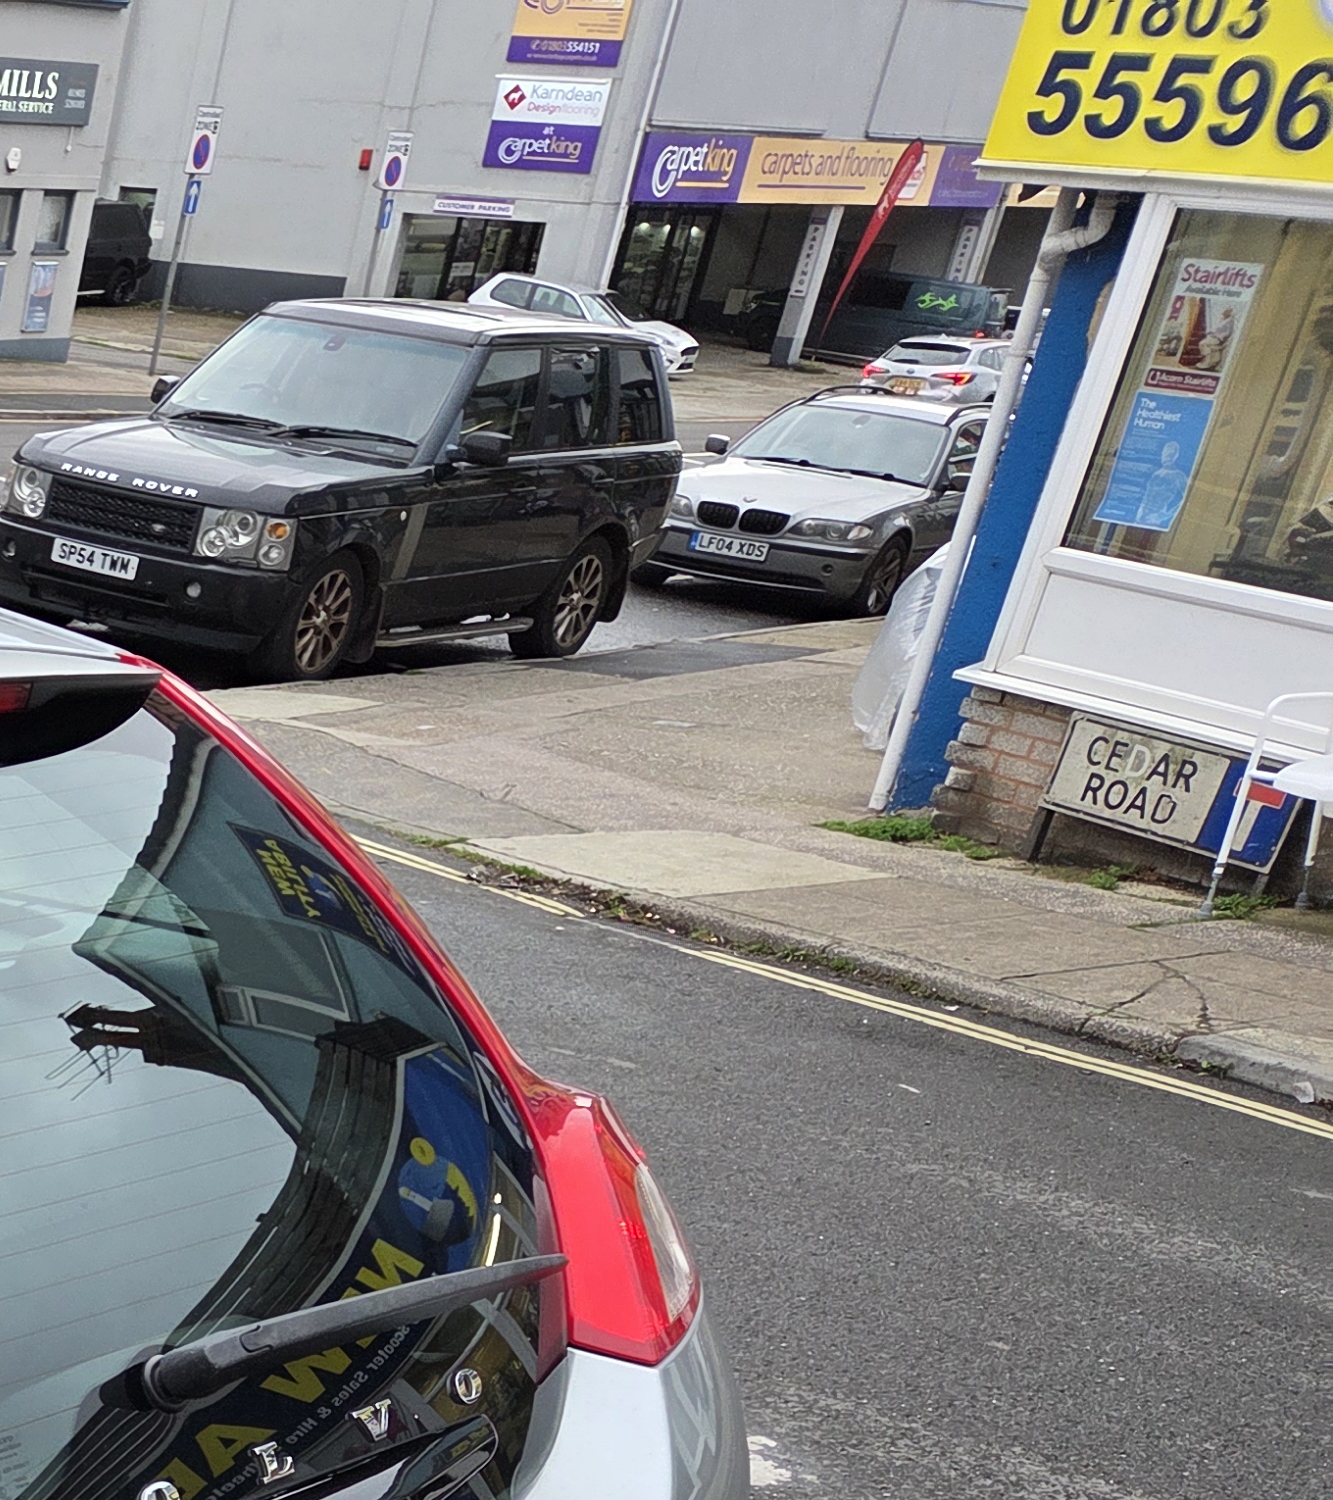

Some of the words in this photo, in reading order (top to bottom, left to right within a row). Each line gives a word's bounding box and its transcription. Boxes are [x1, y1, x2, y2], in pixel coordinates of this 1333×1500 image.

[530, 84, 603, 103] Karndean
[1026, 50, 1333, 152] 55596
[17, 101, 55, 115] SERVICE
[542, 126, 555, 135] at
[761, 150, 814, 183] carpets
[814, 149, 841, 176] and
[840, 149, 894, 186] flooring
[437, 202, 475, 210] CUSTOMER
[478, 204, 511, 213] PARKING
[1181, 262, 1258, 290] Stairlifts
[1184, 284, 1221, 297] Available
[1159, 371, 1183, 384] Acorn
[1140, 398, 1157, 408] The
[1133, 418, 1165, 430] Human
[1136, 408, 1181, 422] Healthiest
[61, 462, 120, 483] RANGE
[132, 477, 199, 498] ROVER
[57, 542, 96, 567] SP54
[698, 534, 735, 553] LF04
[735, 541, 766, 558] XDS
[1086, 735, 1199, 794] CEDAR
[1080, 772, 1178, 824] ROAD
